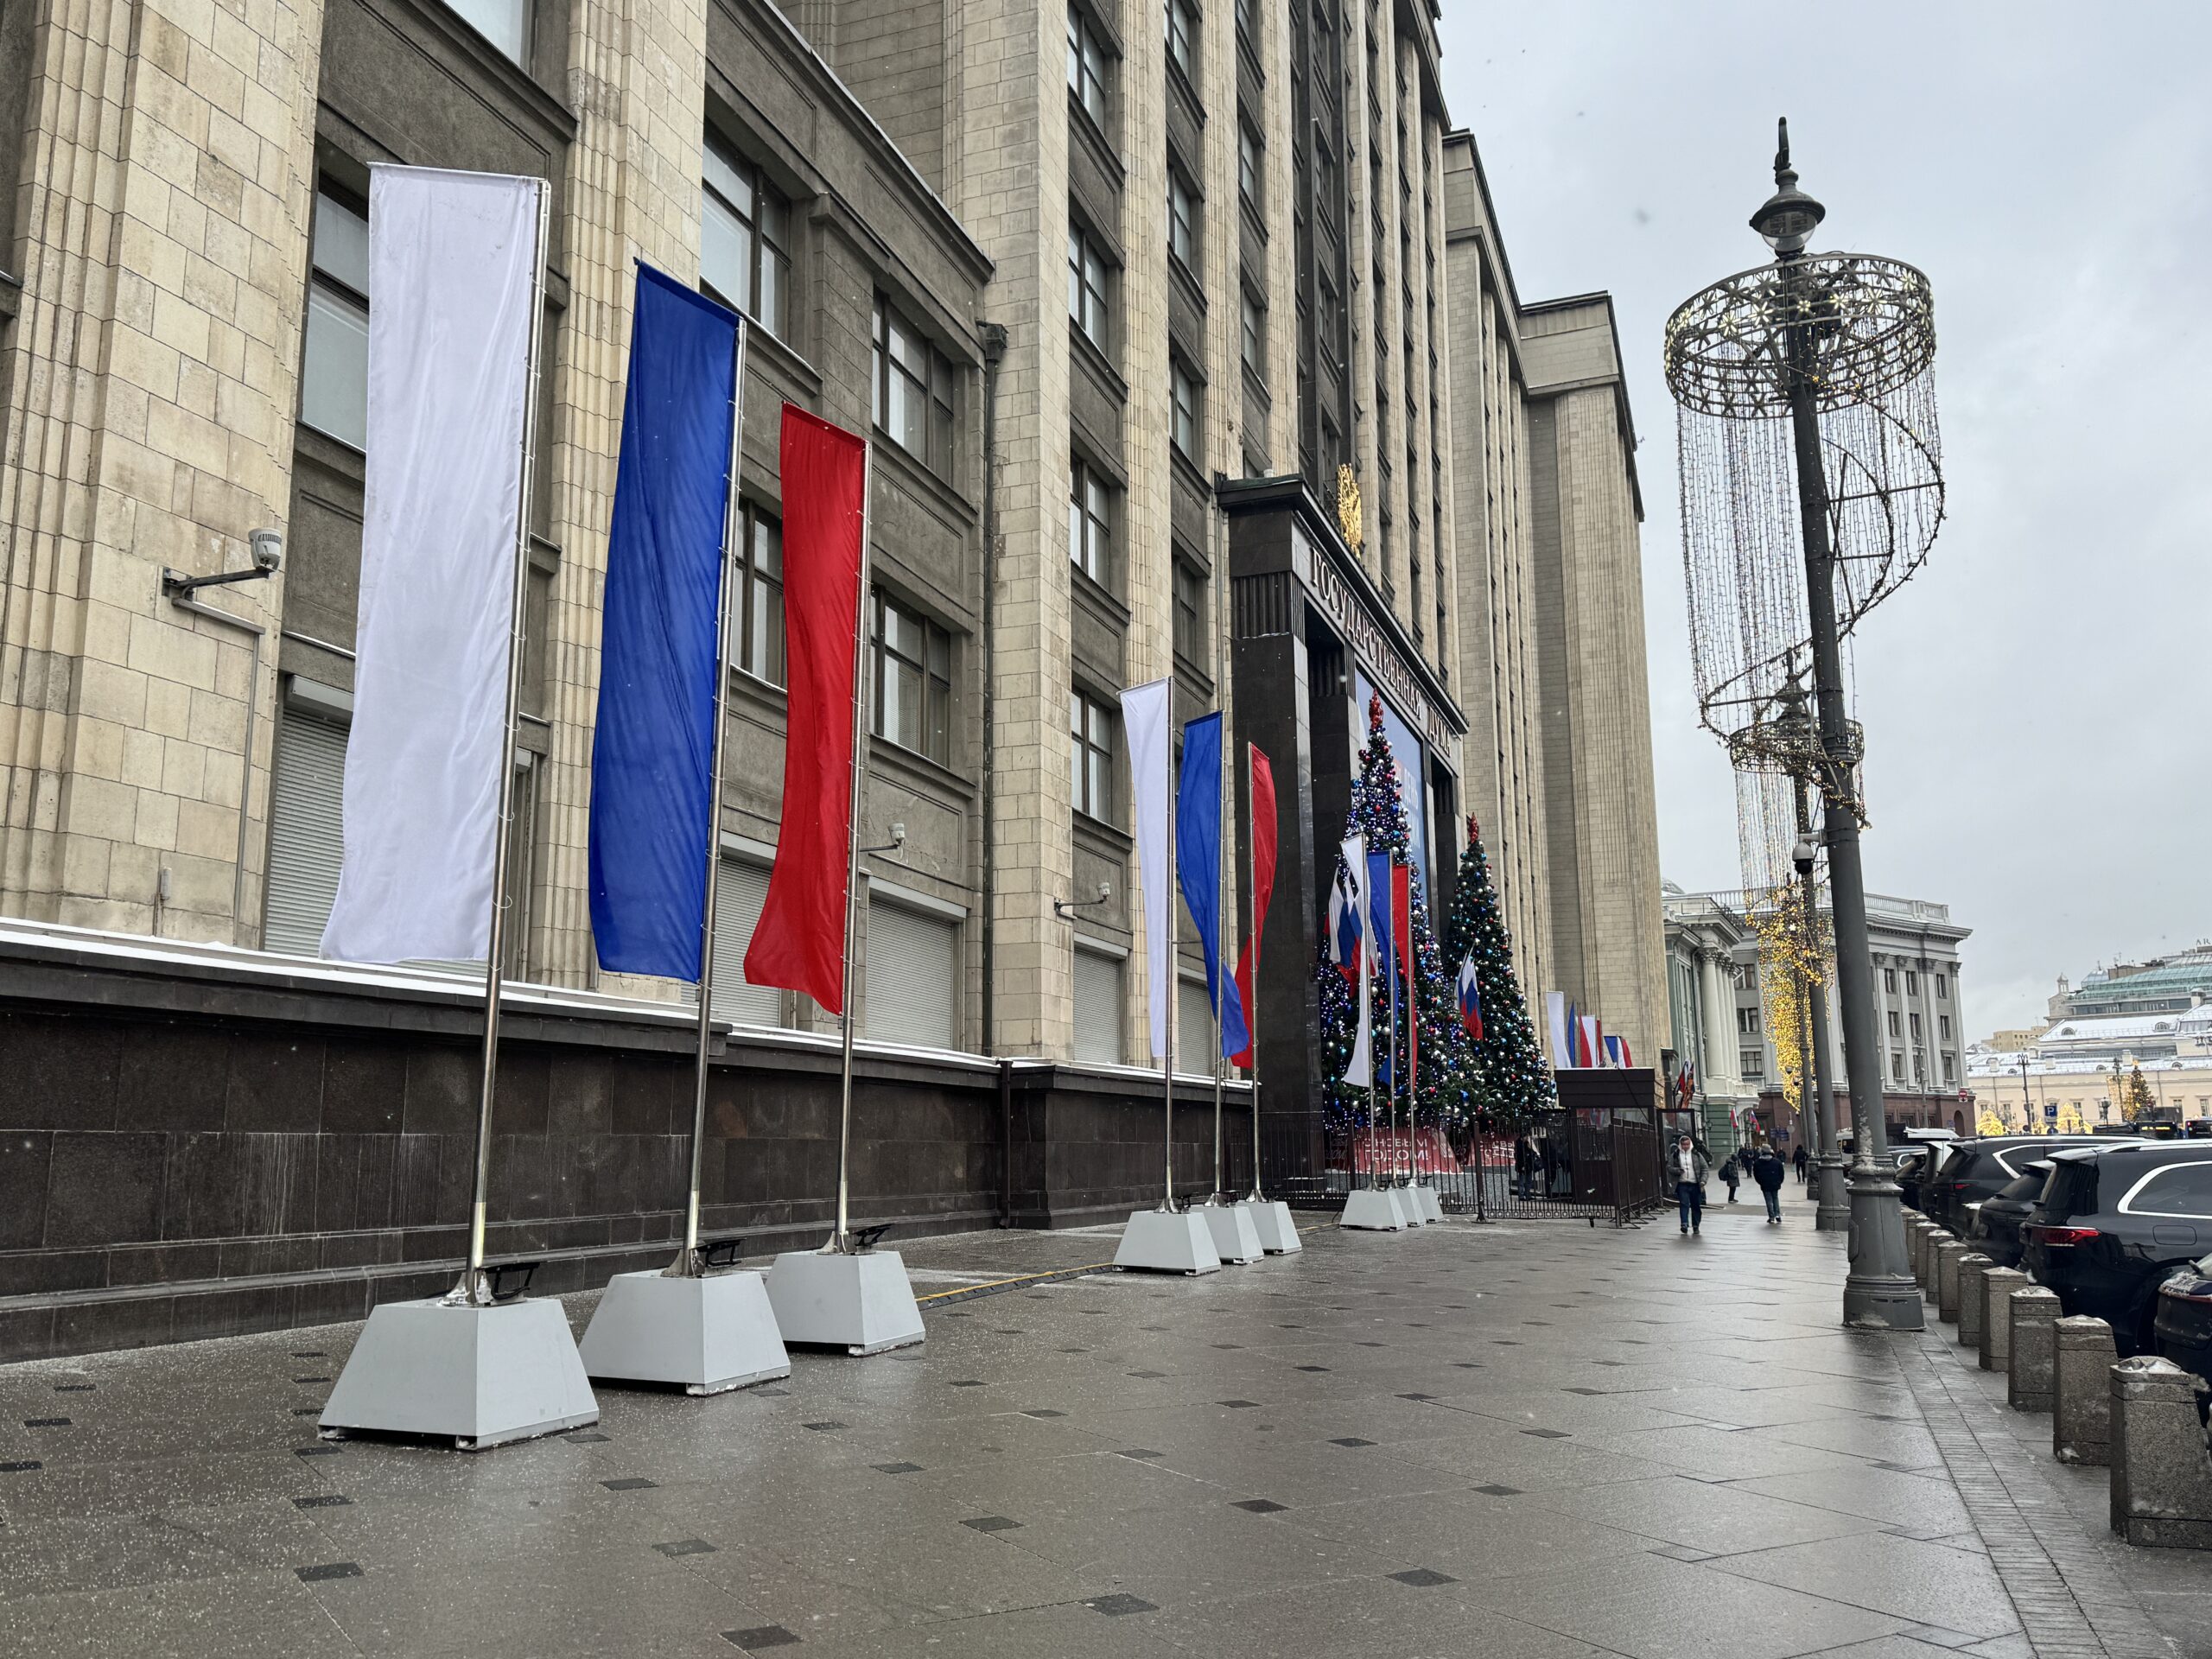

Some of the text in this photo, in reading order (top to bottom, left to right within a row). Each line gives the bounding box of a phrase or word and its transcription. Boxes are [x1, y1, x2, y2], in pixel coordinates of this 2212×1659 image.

[1311, 546, 1452, 758] ГОСУДАРСТВЕННАЯ ДУМА
[2047, 1107, 2055, 1116] P
